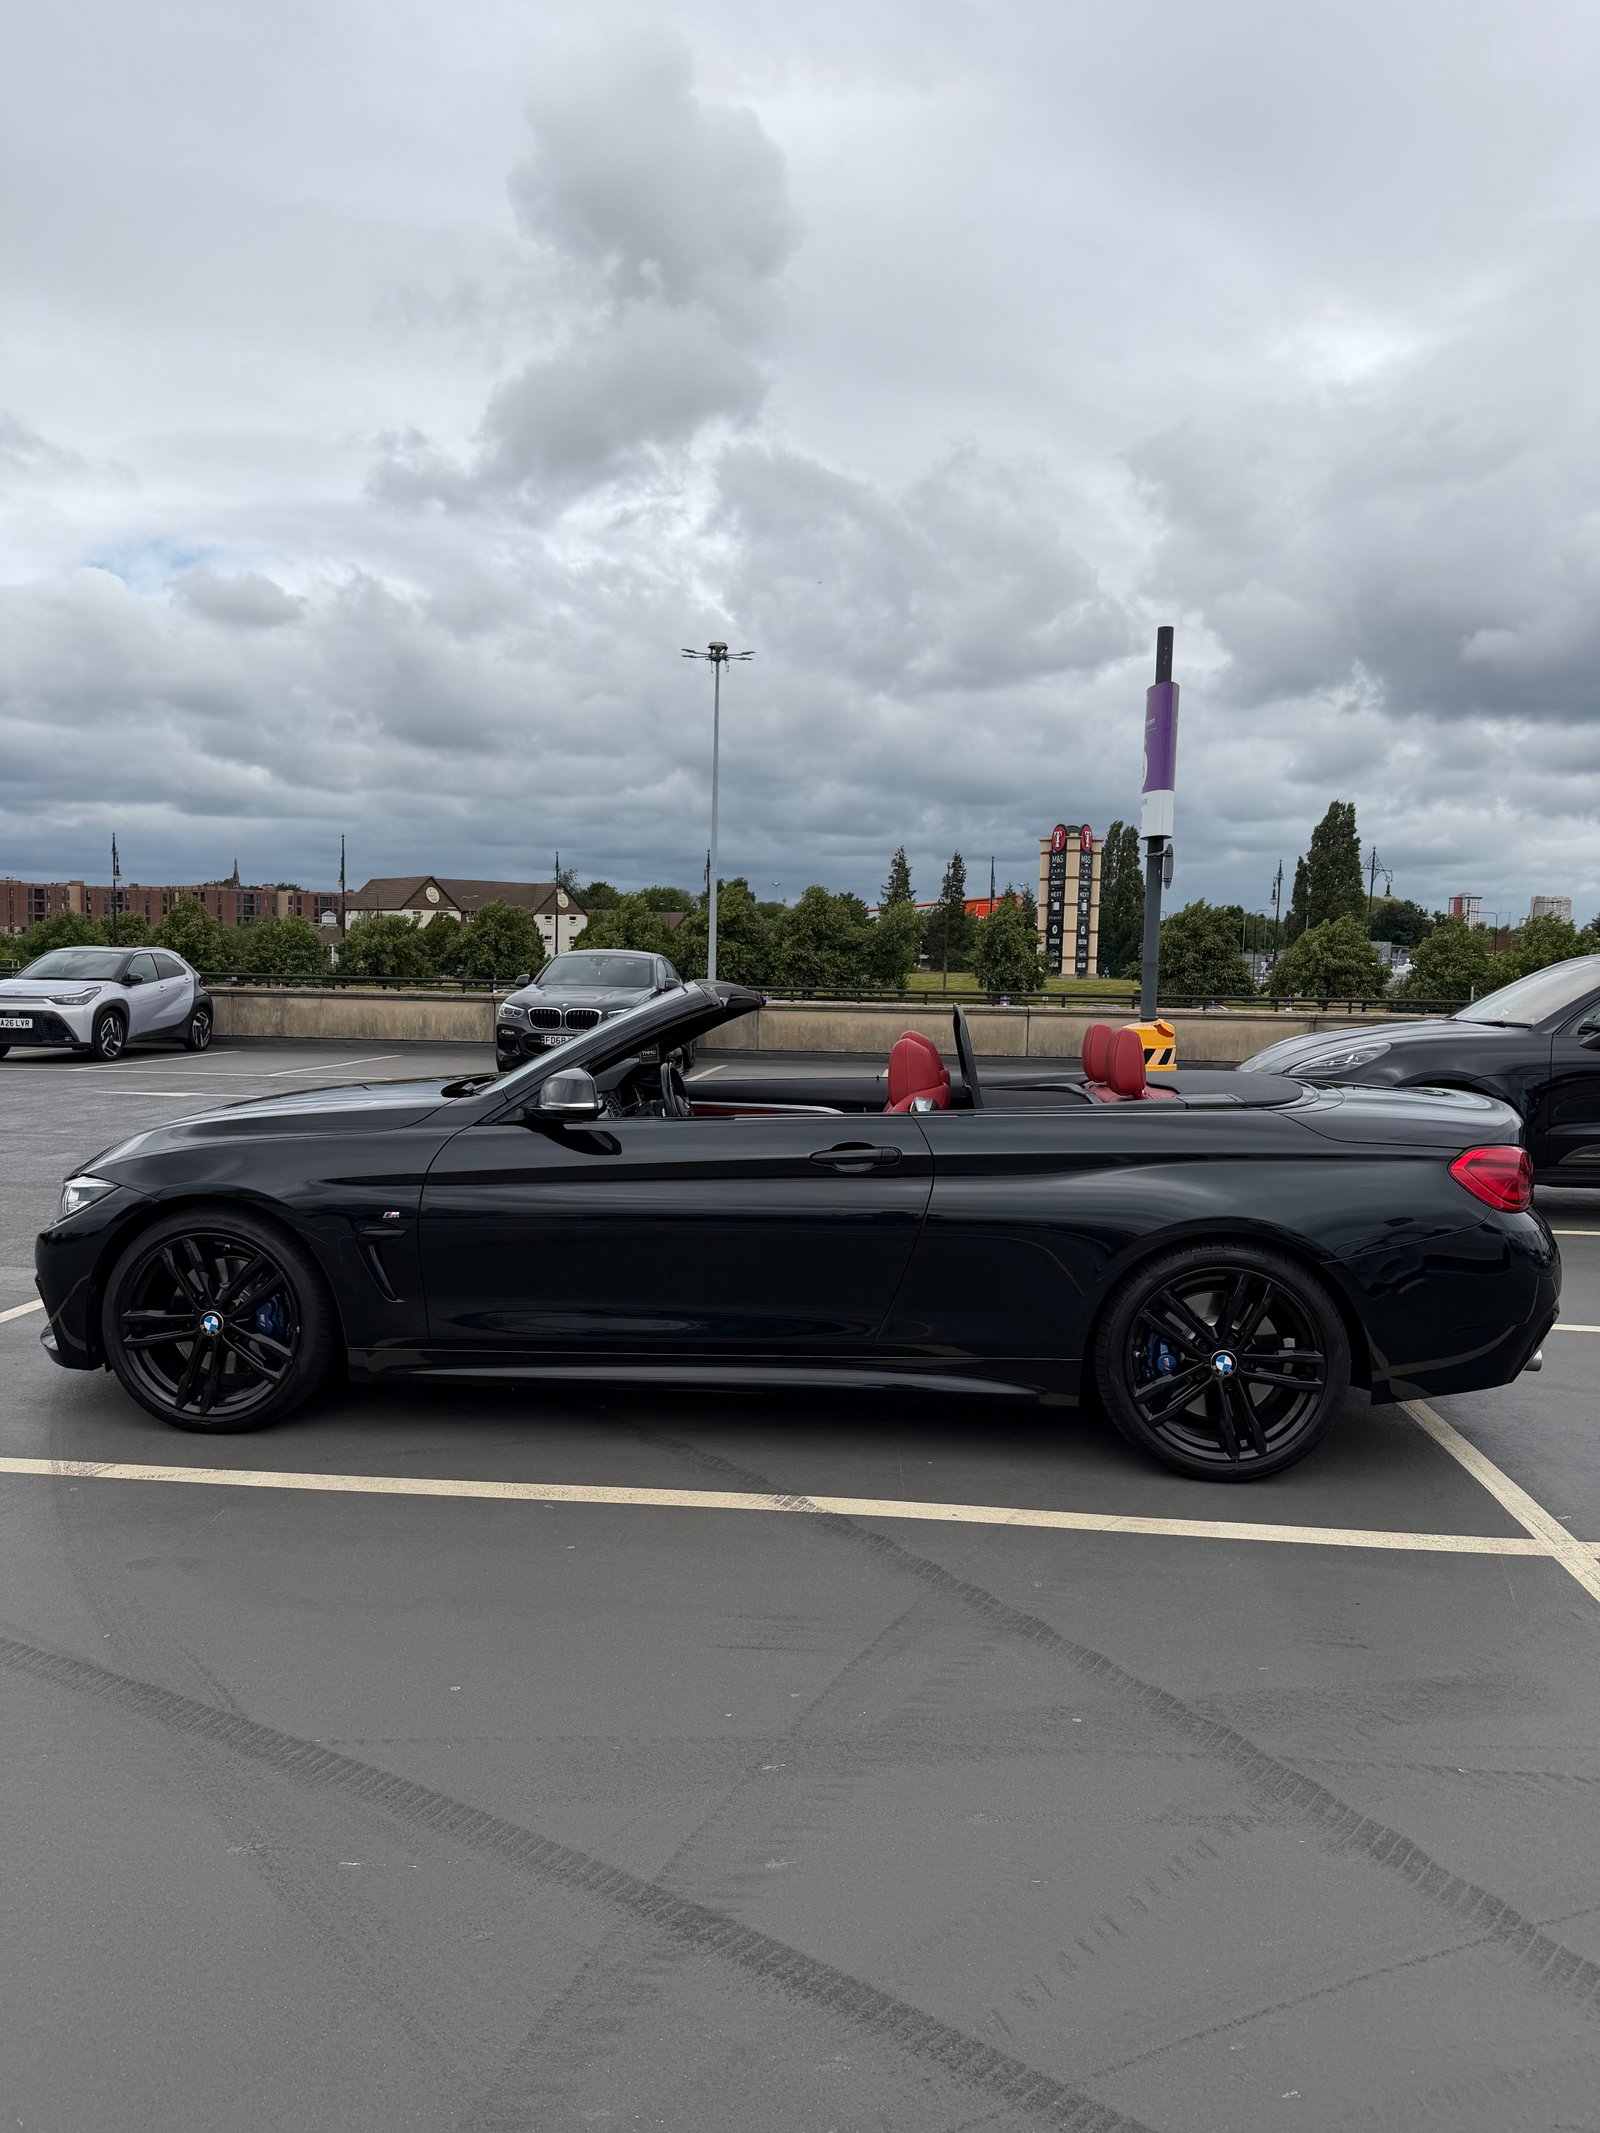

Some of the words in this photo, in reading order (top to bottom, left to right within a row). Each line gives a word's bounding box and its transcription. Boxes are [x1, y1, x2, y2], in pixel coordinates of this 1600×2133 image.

[1054, 831, 1062, 847] T
[1085, 831, 1091, 847] T
[1052, 855, 1063, 863] M&S
[1081, 855, 1091, 863] M&S
[15, 1019, 30, 1027] LVR
